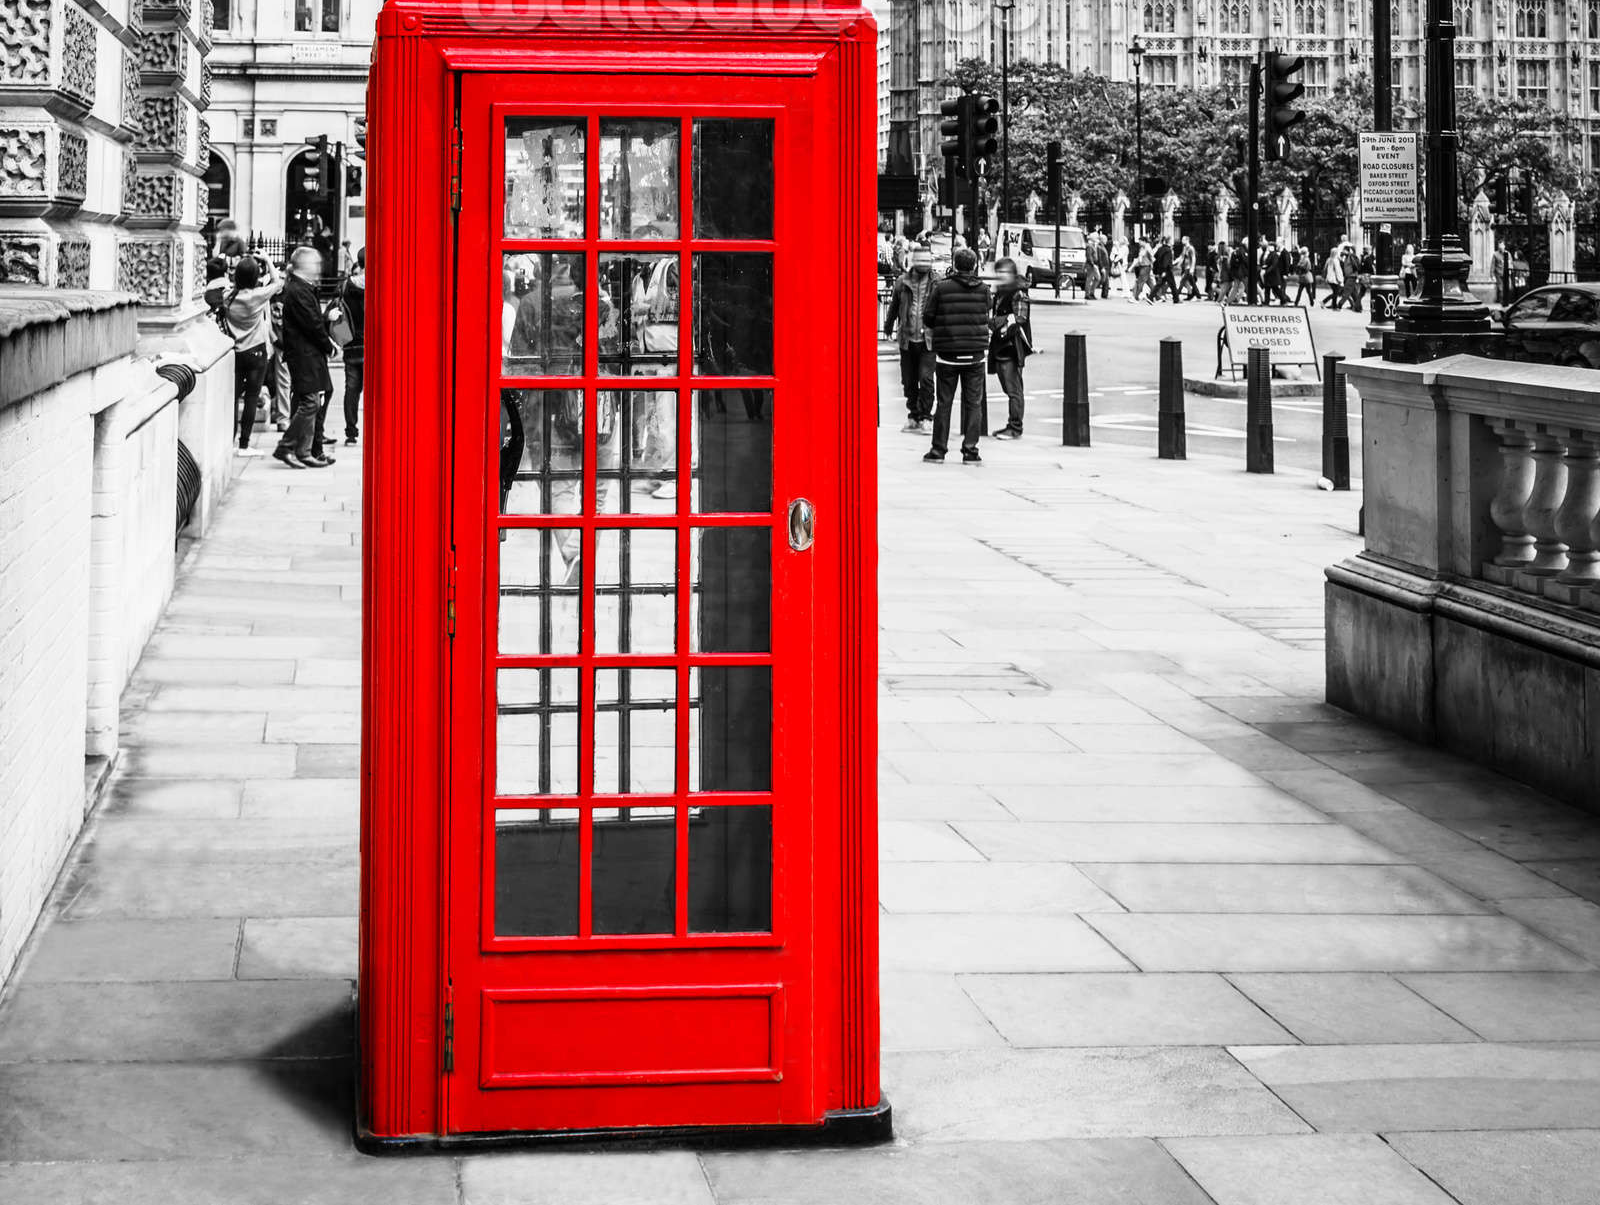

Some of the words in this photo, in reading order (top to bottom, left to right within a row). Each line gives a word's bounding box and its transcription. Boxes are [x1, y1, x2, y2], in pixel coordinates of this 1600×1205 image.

[1229, 314, 1303, 323] BLACKFRIARS
[1236, 326, 1300, 335] UNDERPASS
[1249, 338, 1291, 346] CLOSED
